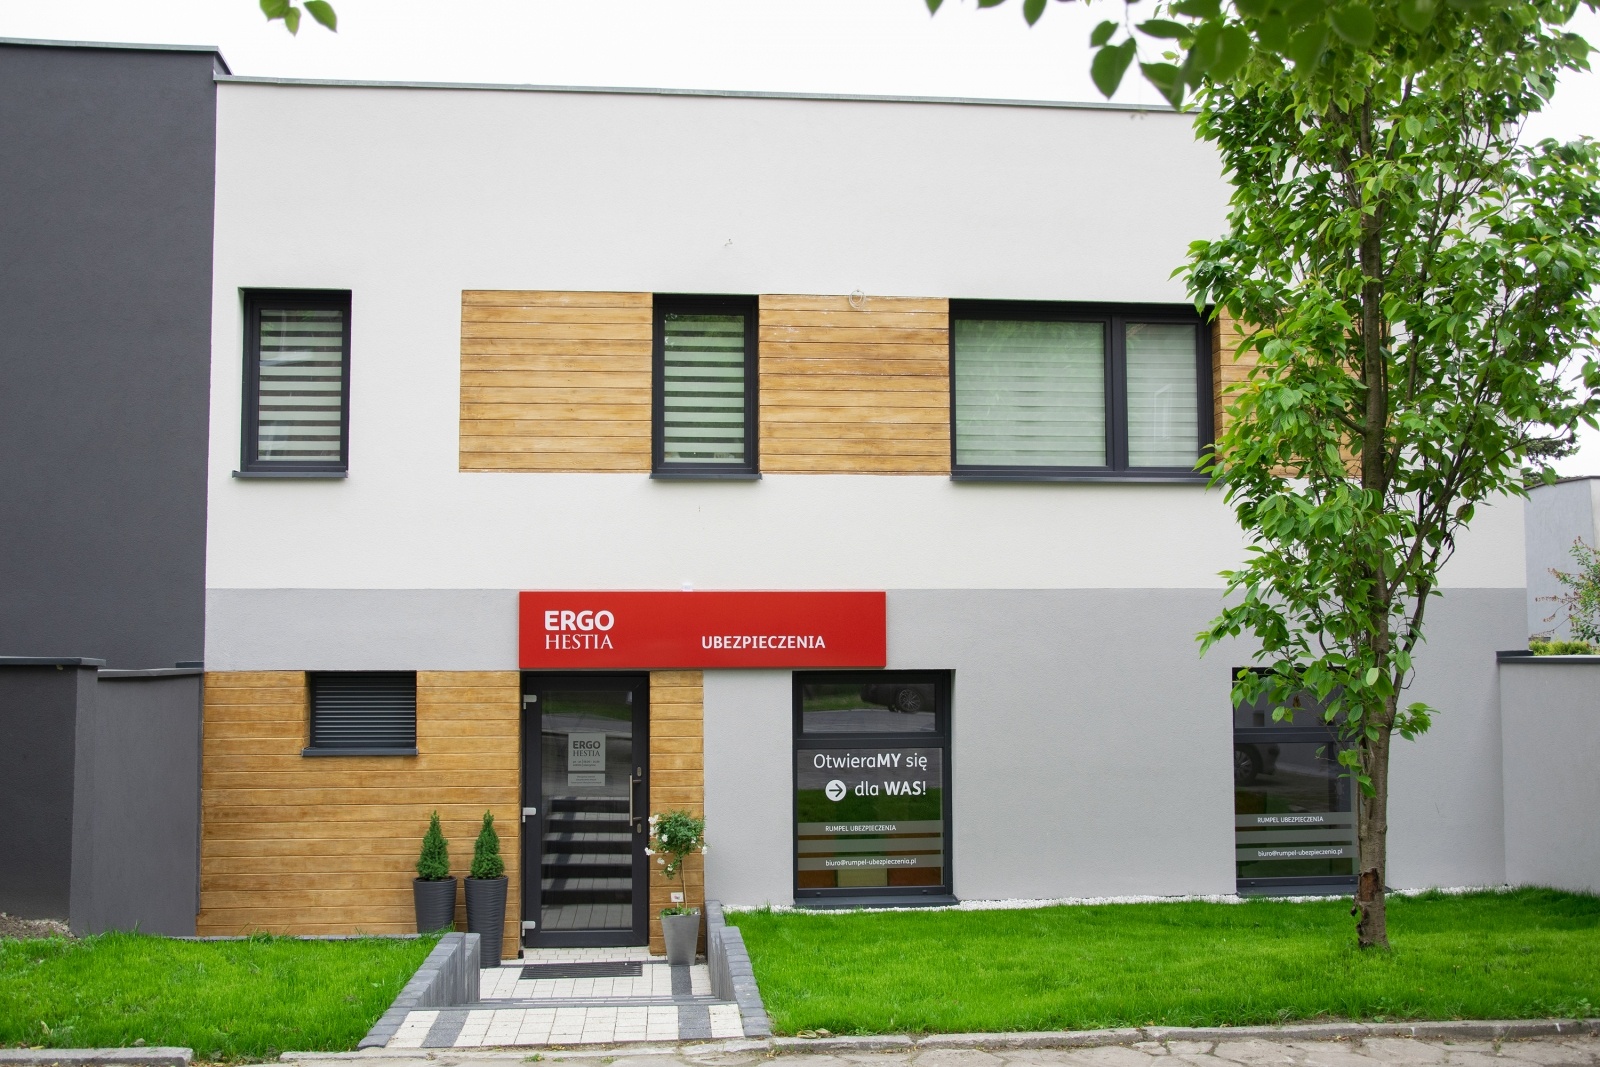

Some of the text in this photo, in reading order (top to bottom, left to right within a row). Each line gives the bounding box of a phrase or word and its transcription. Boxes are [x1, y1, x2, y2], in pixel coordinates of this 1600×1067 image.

[544, 610, 615, 631] ERGO
[545, 634, 614, 650] HESTIA
[701, 635, 826, 649] UBEZPIECZENIA
[572, 740, 601, 749] ERGO
[813, 753, 928, 771] OtwieraMY się
[854, 780, 927, 796] dla WAS!
[1257, 848, 1343, 857] biuro@rumpel-ubezpieczenia.pl
[825, 858, 917, 867] biuro@rumpel-ubezpieczenia.pl
